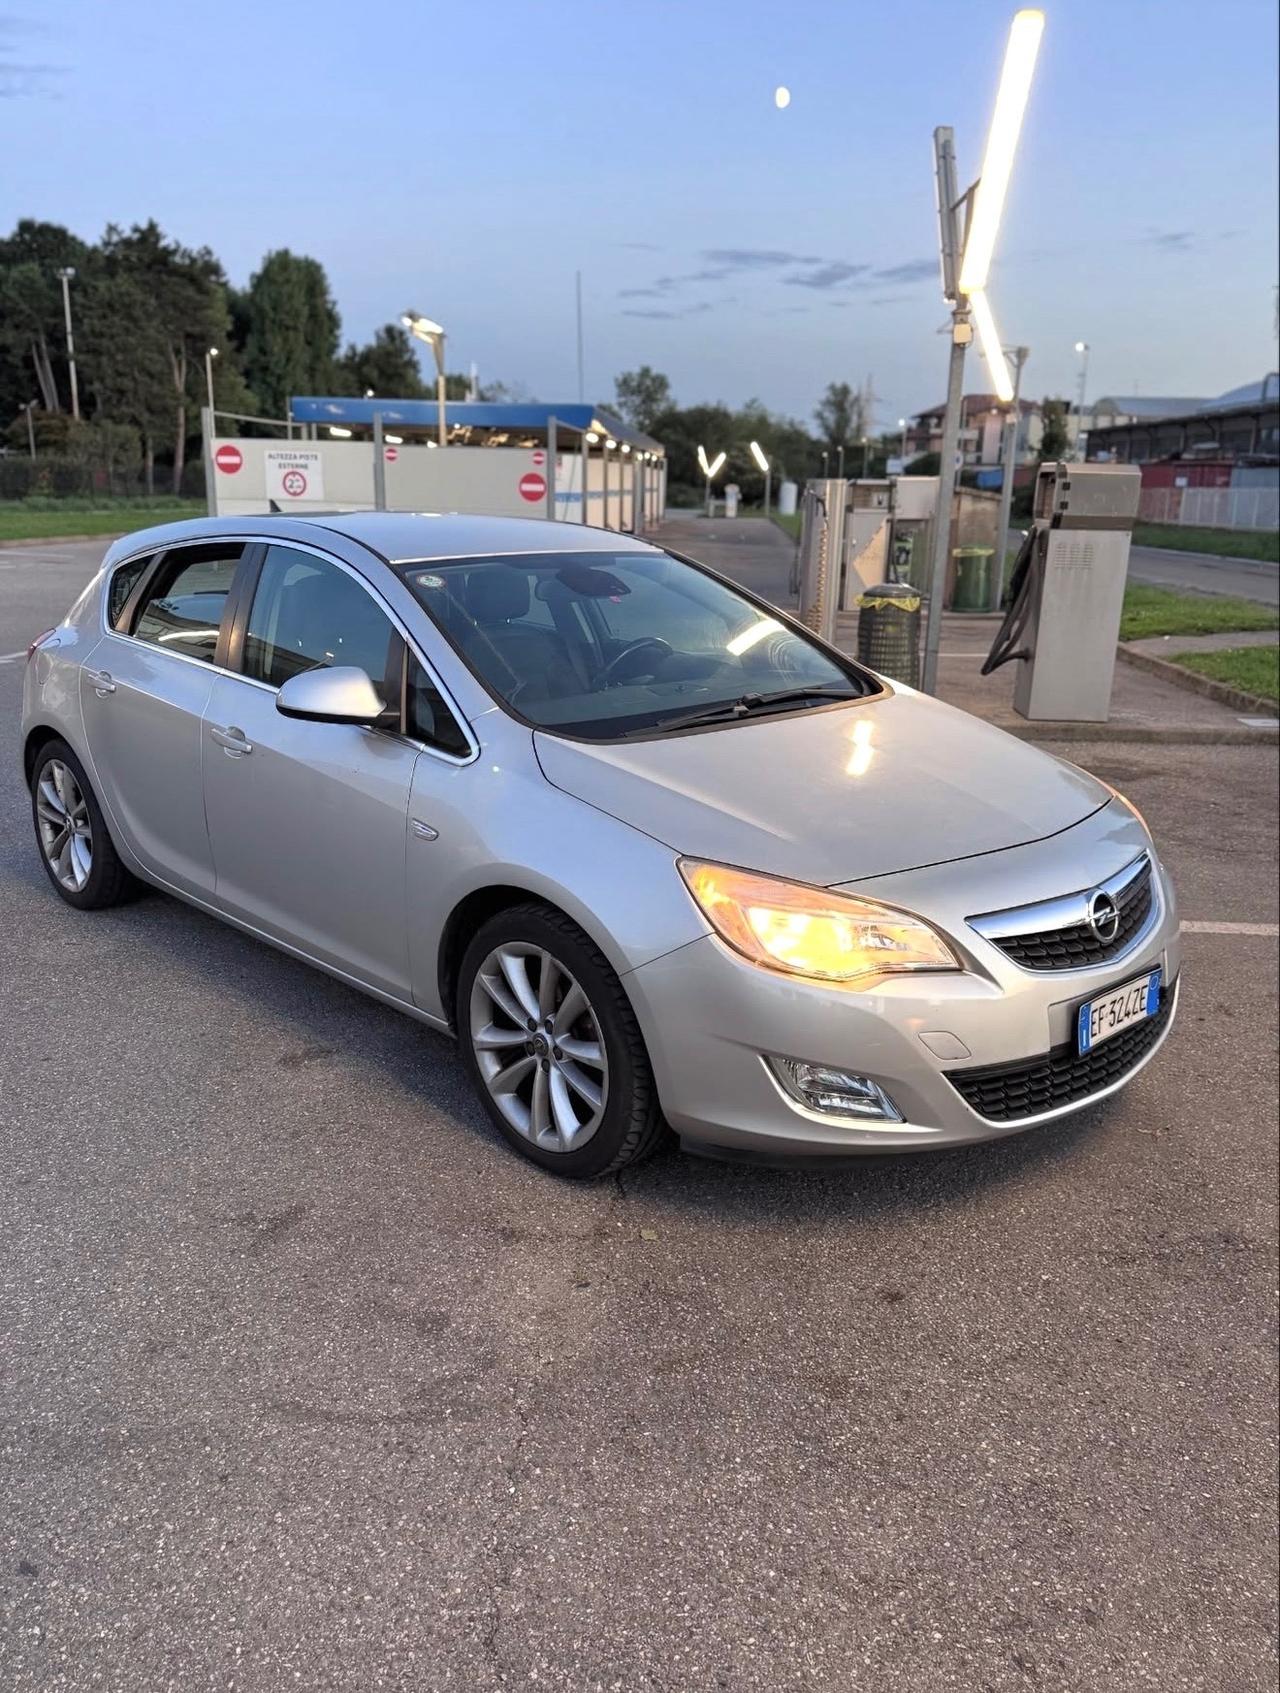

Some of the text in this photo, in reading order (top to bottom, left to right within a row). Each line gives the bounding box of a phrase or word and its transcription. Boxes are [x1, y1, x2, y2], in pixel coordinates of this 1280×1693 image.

[267, 453, 318, 461] ALTEZZA PISTE
[278, 462, 309, 470] ESTERNE
